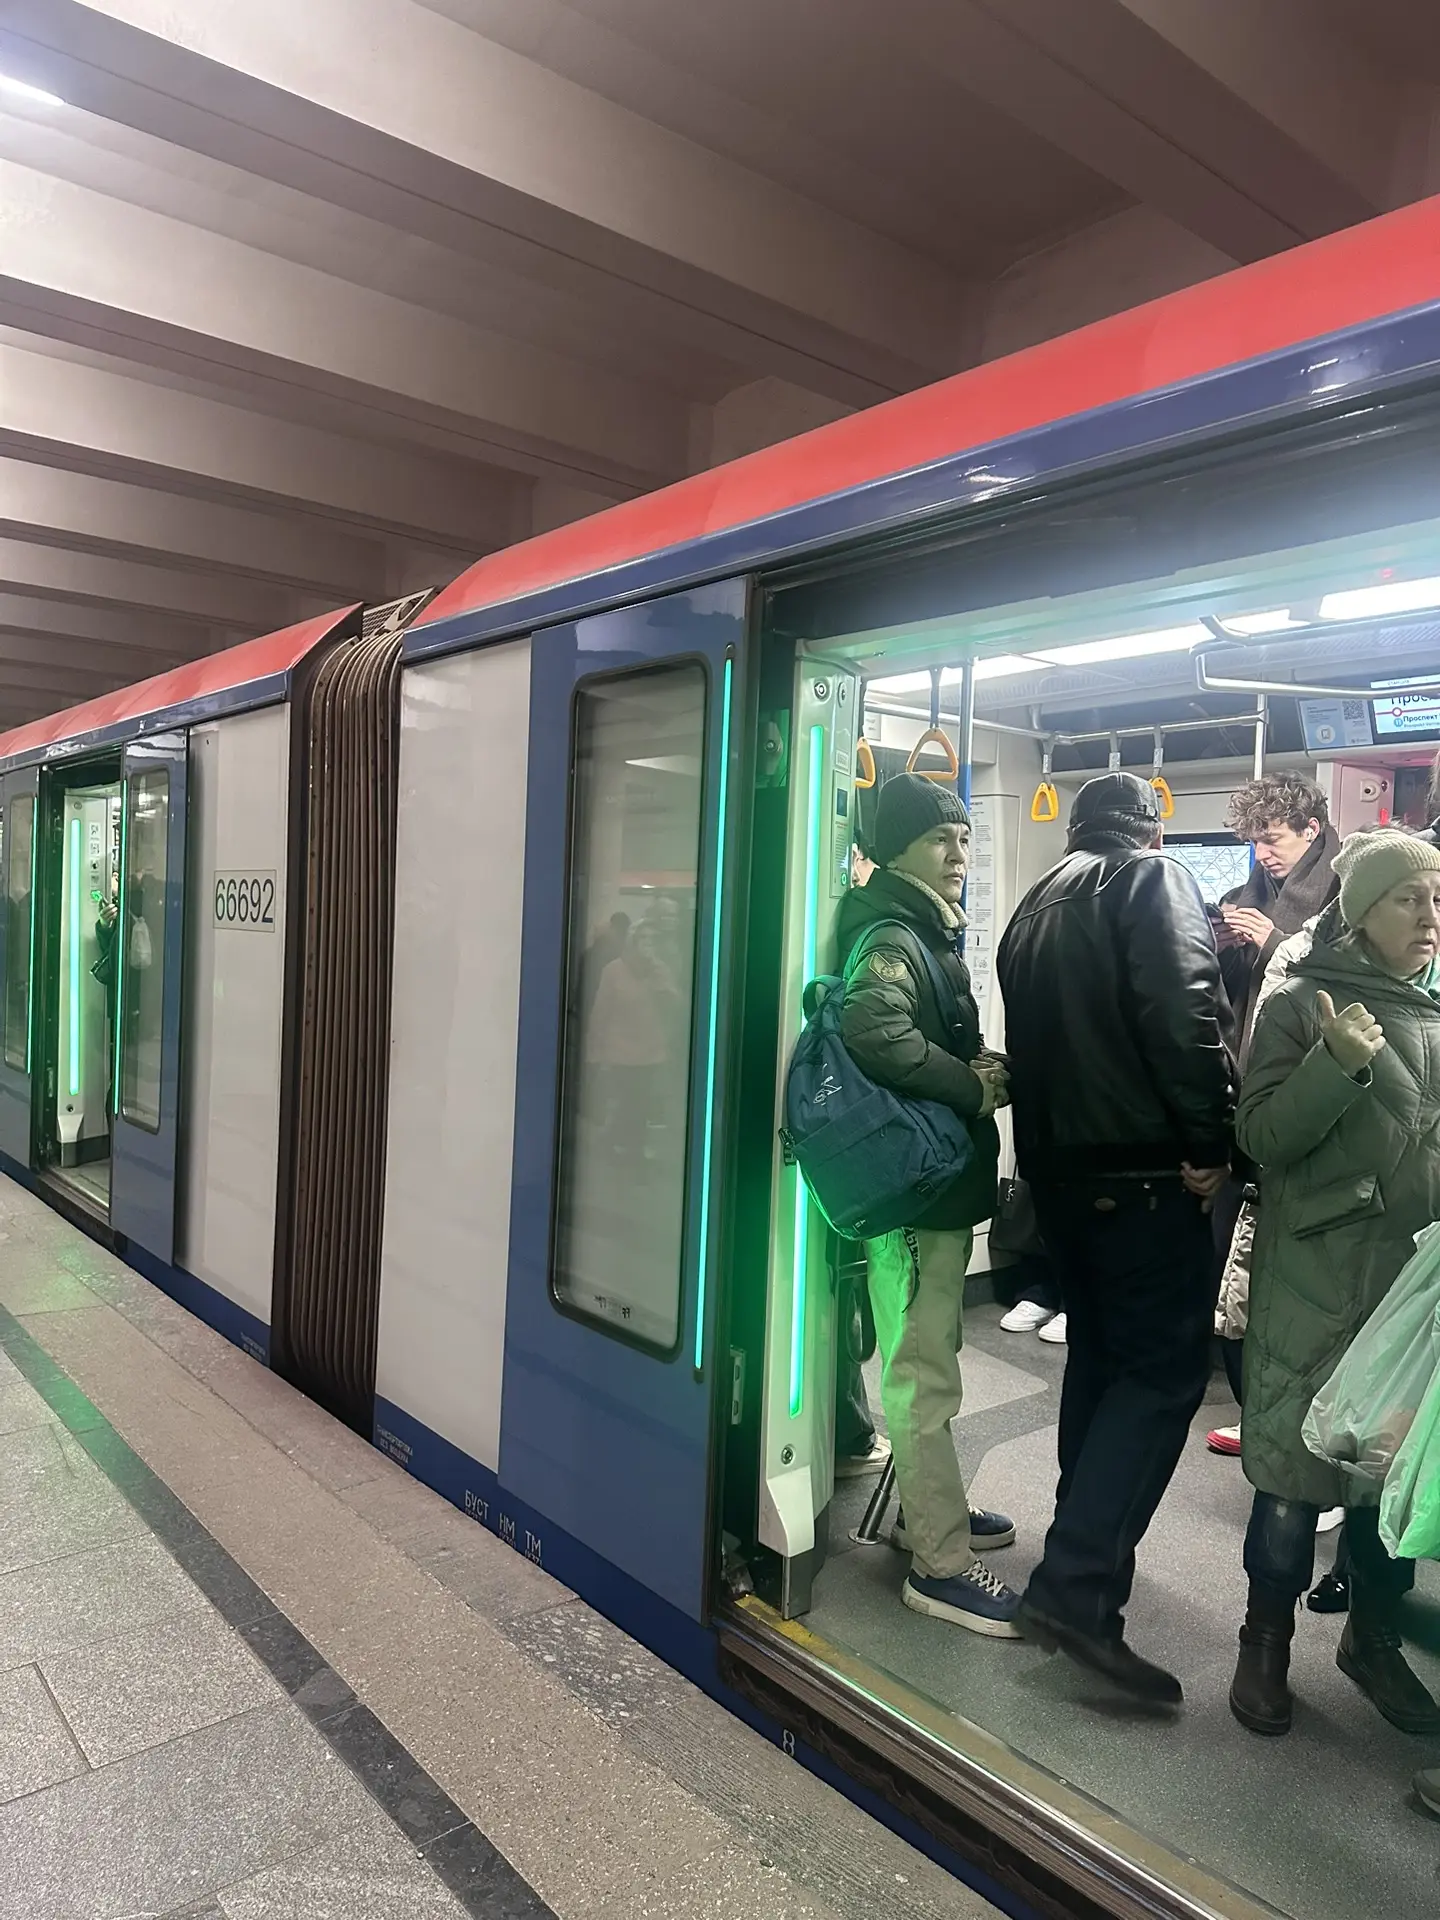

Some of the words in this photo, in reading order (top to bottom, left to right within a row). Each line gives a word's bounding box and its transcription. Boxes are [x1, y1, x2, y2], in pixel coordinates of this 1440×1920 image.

[1391, 694, 1431, 706] Прос
[215, 878, 274, 923] 66692
[465, 1489, 489, 1520] БУСТ
[499, 1512, 515, 1540] НМ
[525, 1530, 541, 1558] ТМ
[782, 1728, 796, 1757] 8
